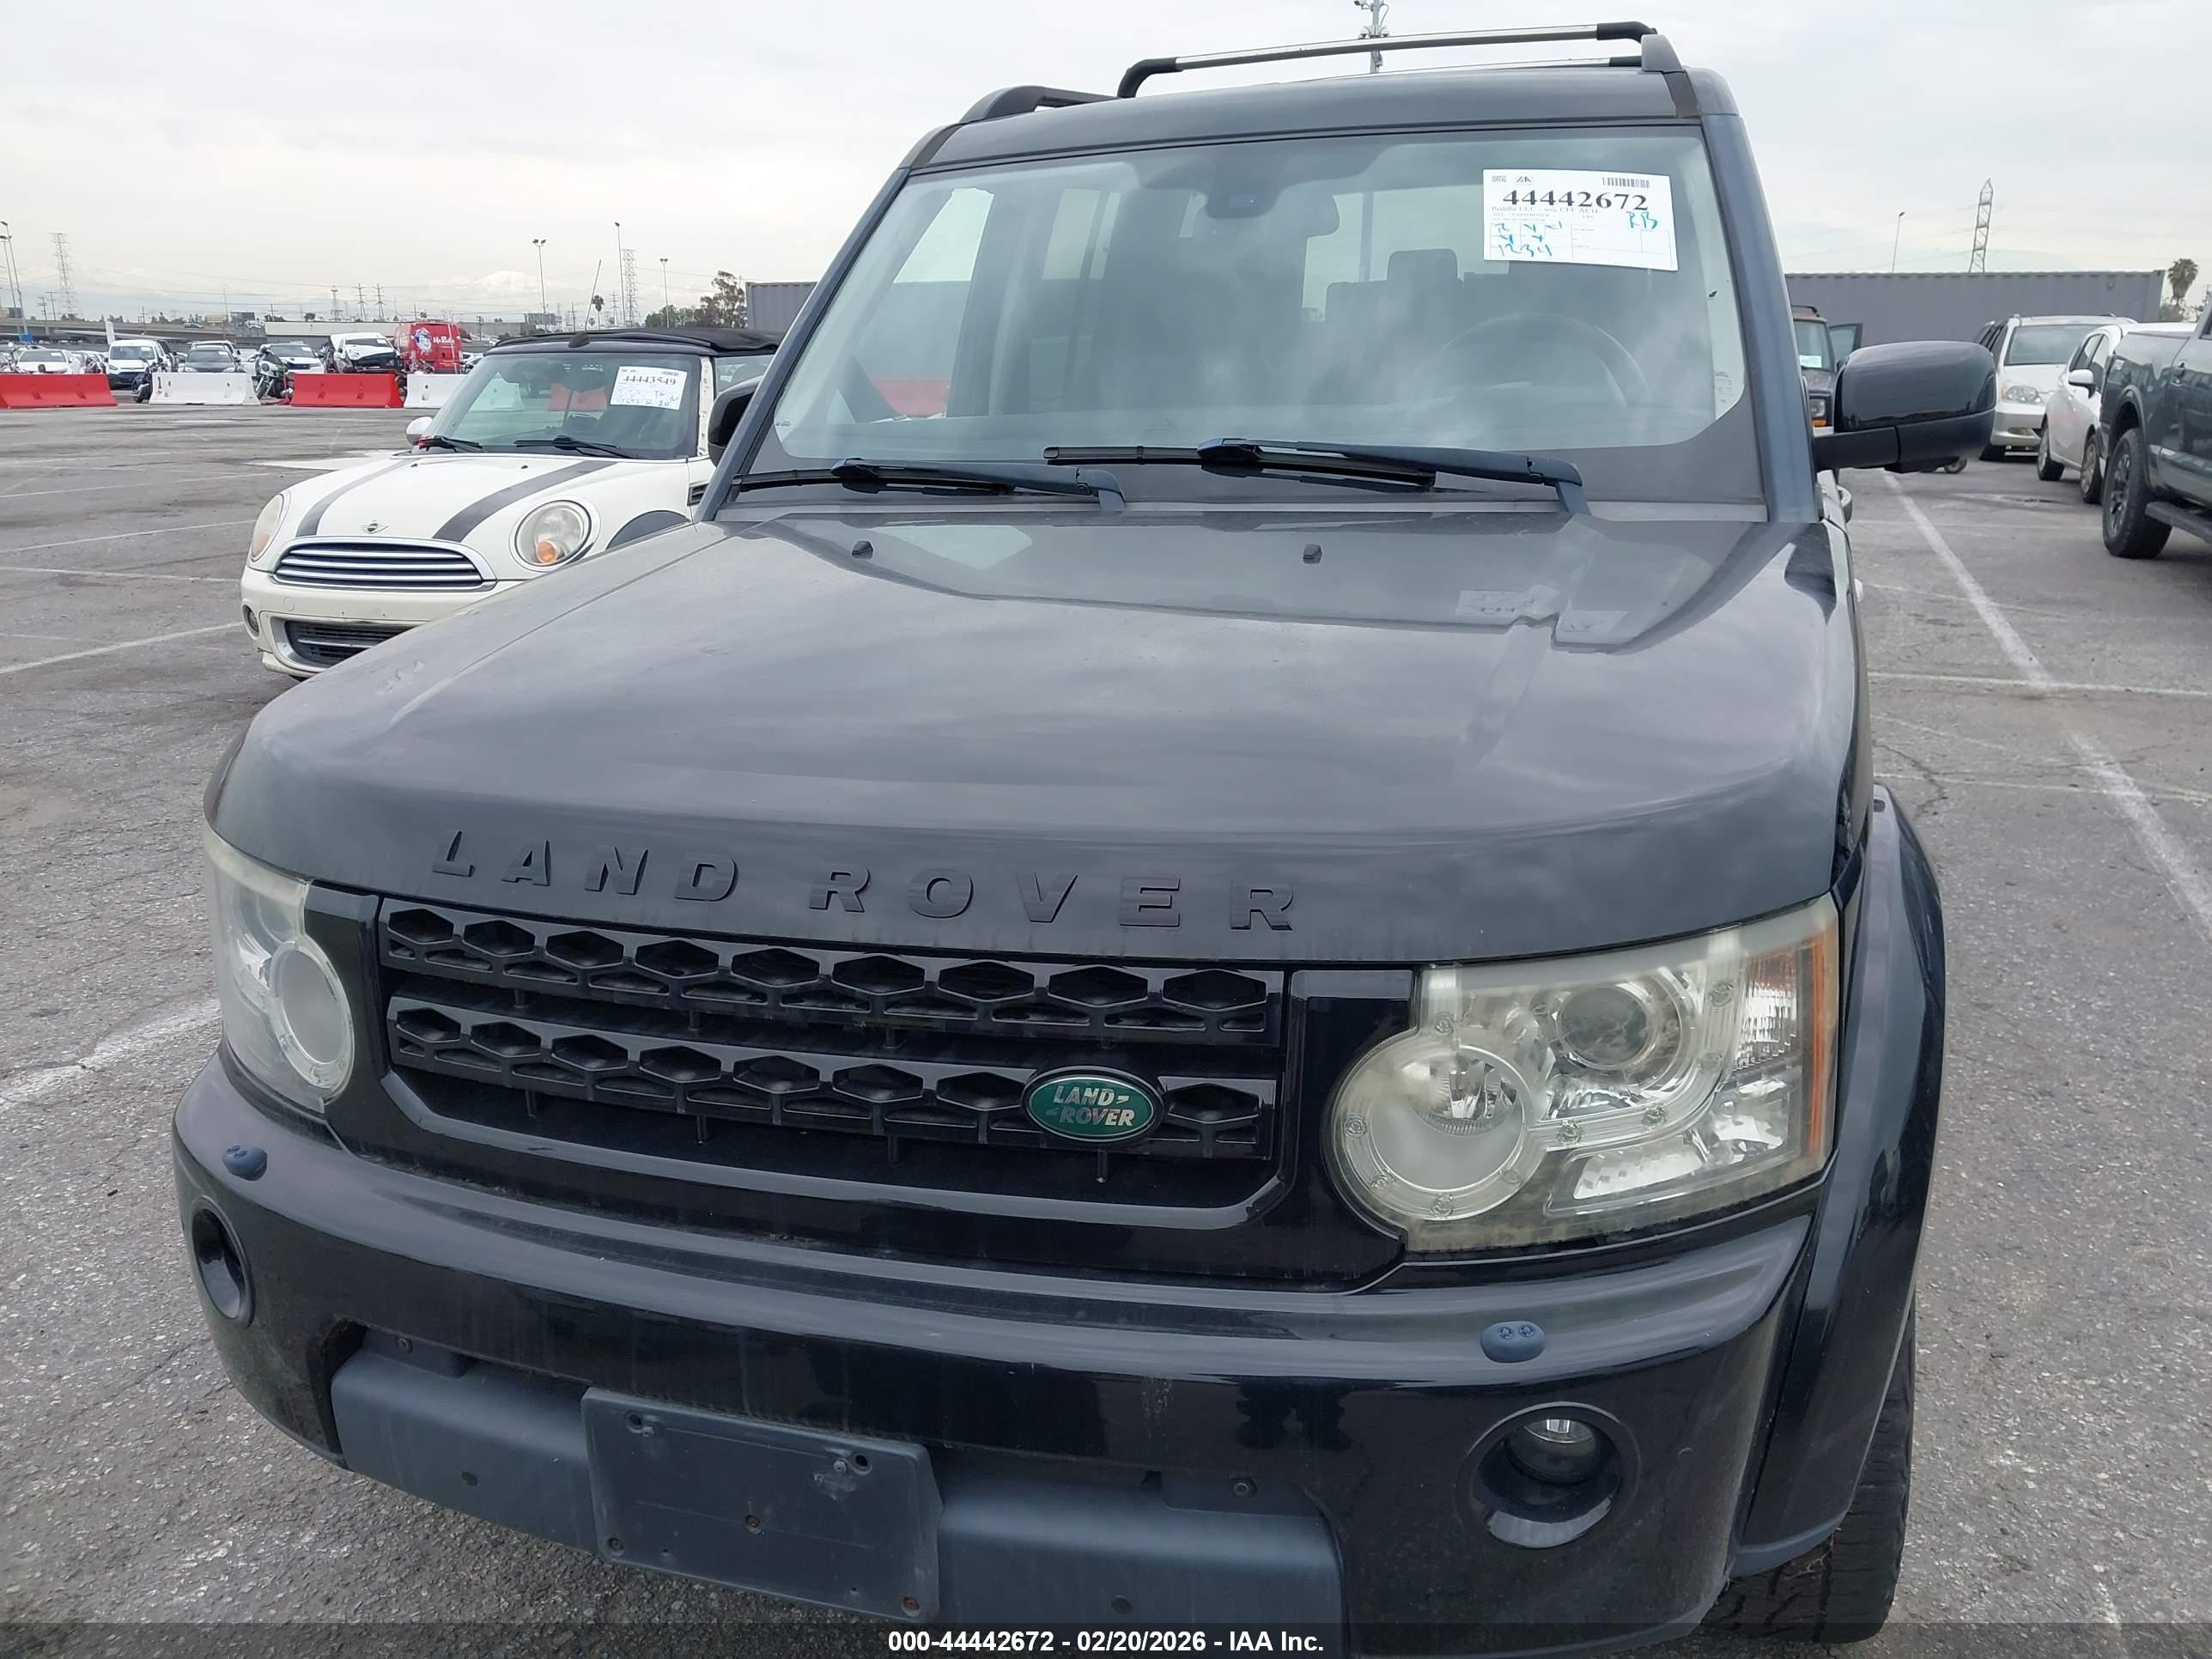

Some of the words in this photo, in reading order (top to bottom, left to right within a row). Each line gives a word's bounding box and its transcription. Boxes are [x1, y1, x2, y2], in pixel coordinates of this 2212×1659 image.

[1503, 190, 1649, 210] 44442672
[431, 829, 738, 901] LAND
[809, 863, 1294, 930] ROVER
[1054, 1086, 1115, 1105] LAND
[1059, 1106, 1134, 1127] ROVER
